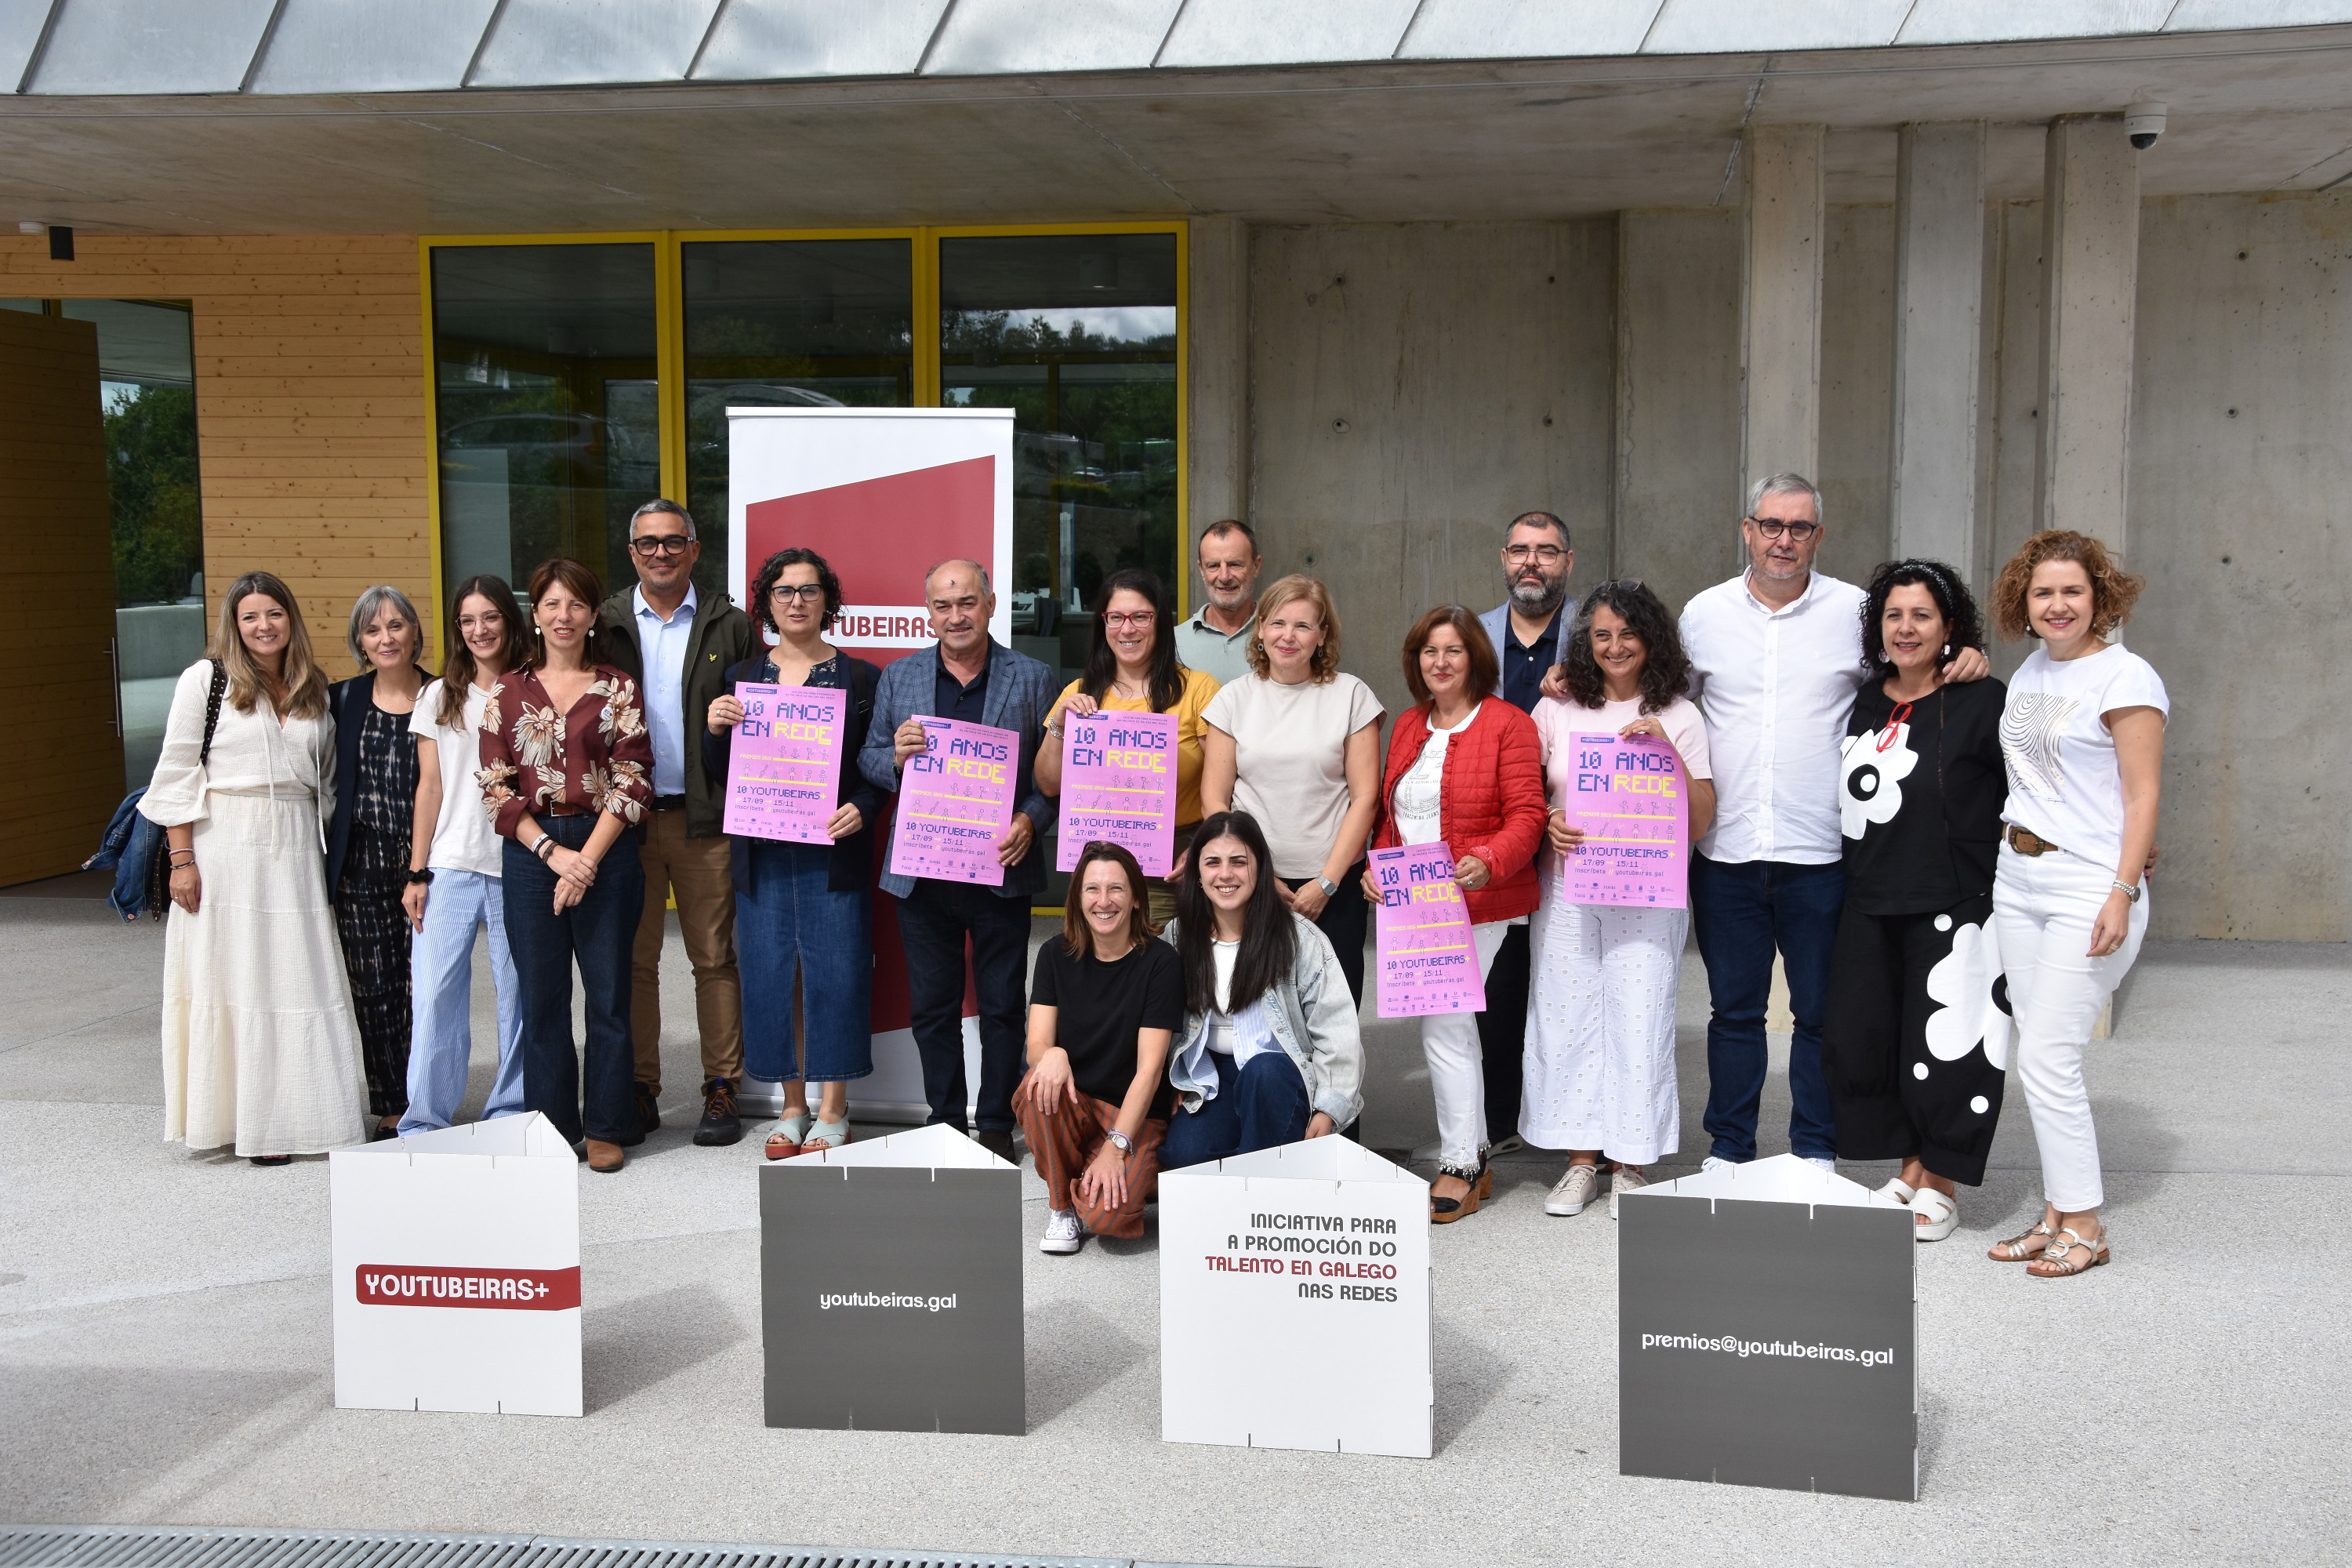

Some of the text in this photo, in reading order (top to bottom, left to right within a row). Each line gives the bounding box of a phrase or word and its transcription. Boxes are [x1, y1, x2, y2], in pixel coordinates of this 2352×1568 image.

[829, 616, 938, 638] TUBEIRAS
[745, 700, 834, 722] 10 ANOS
[742, 720, 833, 745] EN REDE
[1074, 727, 1167, 749] 10 ANOS
[927, 735, 1007, 760] 0 ANOS
[913, 754, 1007, 784] EN REDE
[1073, 748, 1167, 773] EN REDE
[1580, 751, 1675, 772] 10 ANOS
[1578, 774, 1677, 797] EN REDE
[772, 808, 816, 816] youtubeiras.gal
[906, 822, 916, 830] 10
[941, 846, 985, 855] youtubeiras.gal
[1576, 846, 1587, 855] 10
[1381, 860, 1454, 885] 10 ANOS
[1384, 882, 1461, 907] EN REDE
[1387, 961, 1397, 970] 10
[1423, 977, 1465, 986] youtubeiras.gal
[1250, 1213, 1396, 1234] INICIATIVA PARA
[1228, 1234, 1397, 1258] A PROMOCIÓN DO
[1204, 1256, 1397, 1279] TALENTO EN GALEGO
[365, 1274, 550, 1301] YOUTUBEIRAS+
[1298, 1283, 1398, 1302] NAS REDES
[820, 1291, 956, 1312] youtubeiras.gal
[1642, 1333, 1893, 1367] premios@youtubeiras.gal
